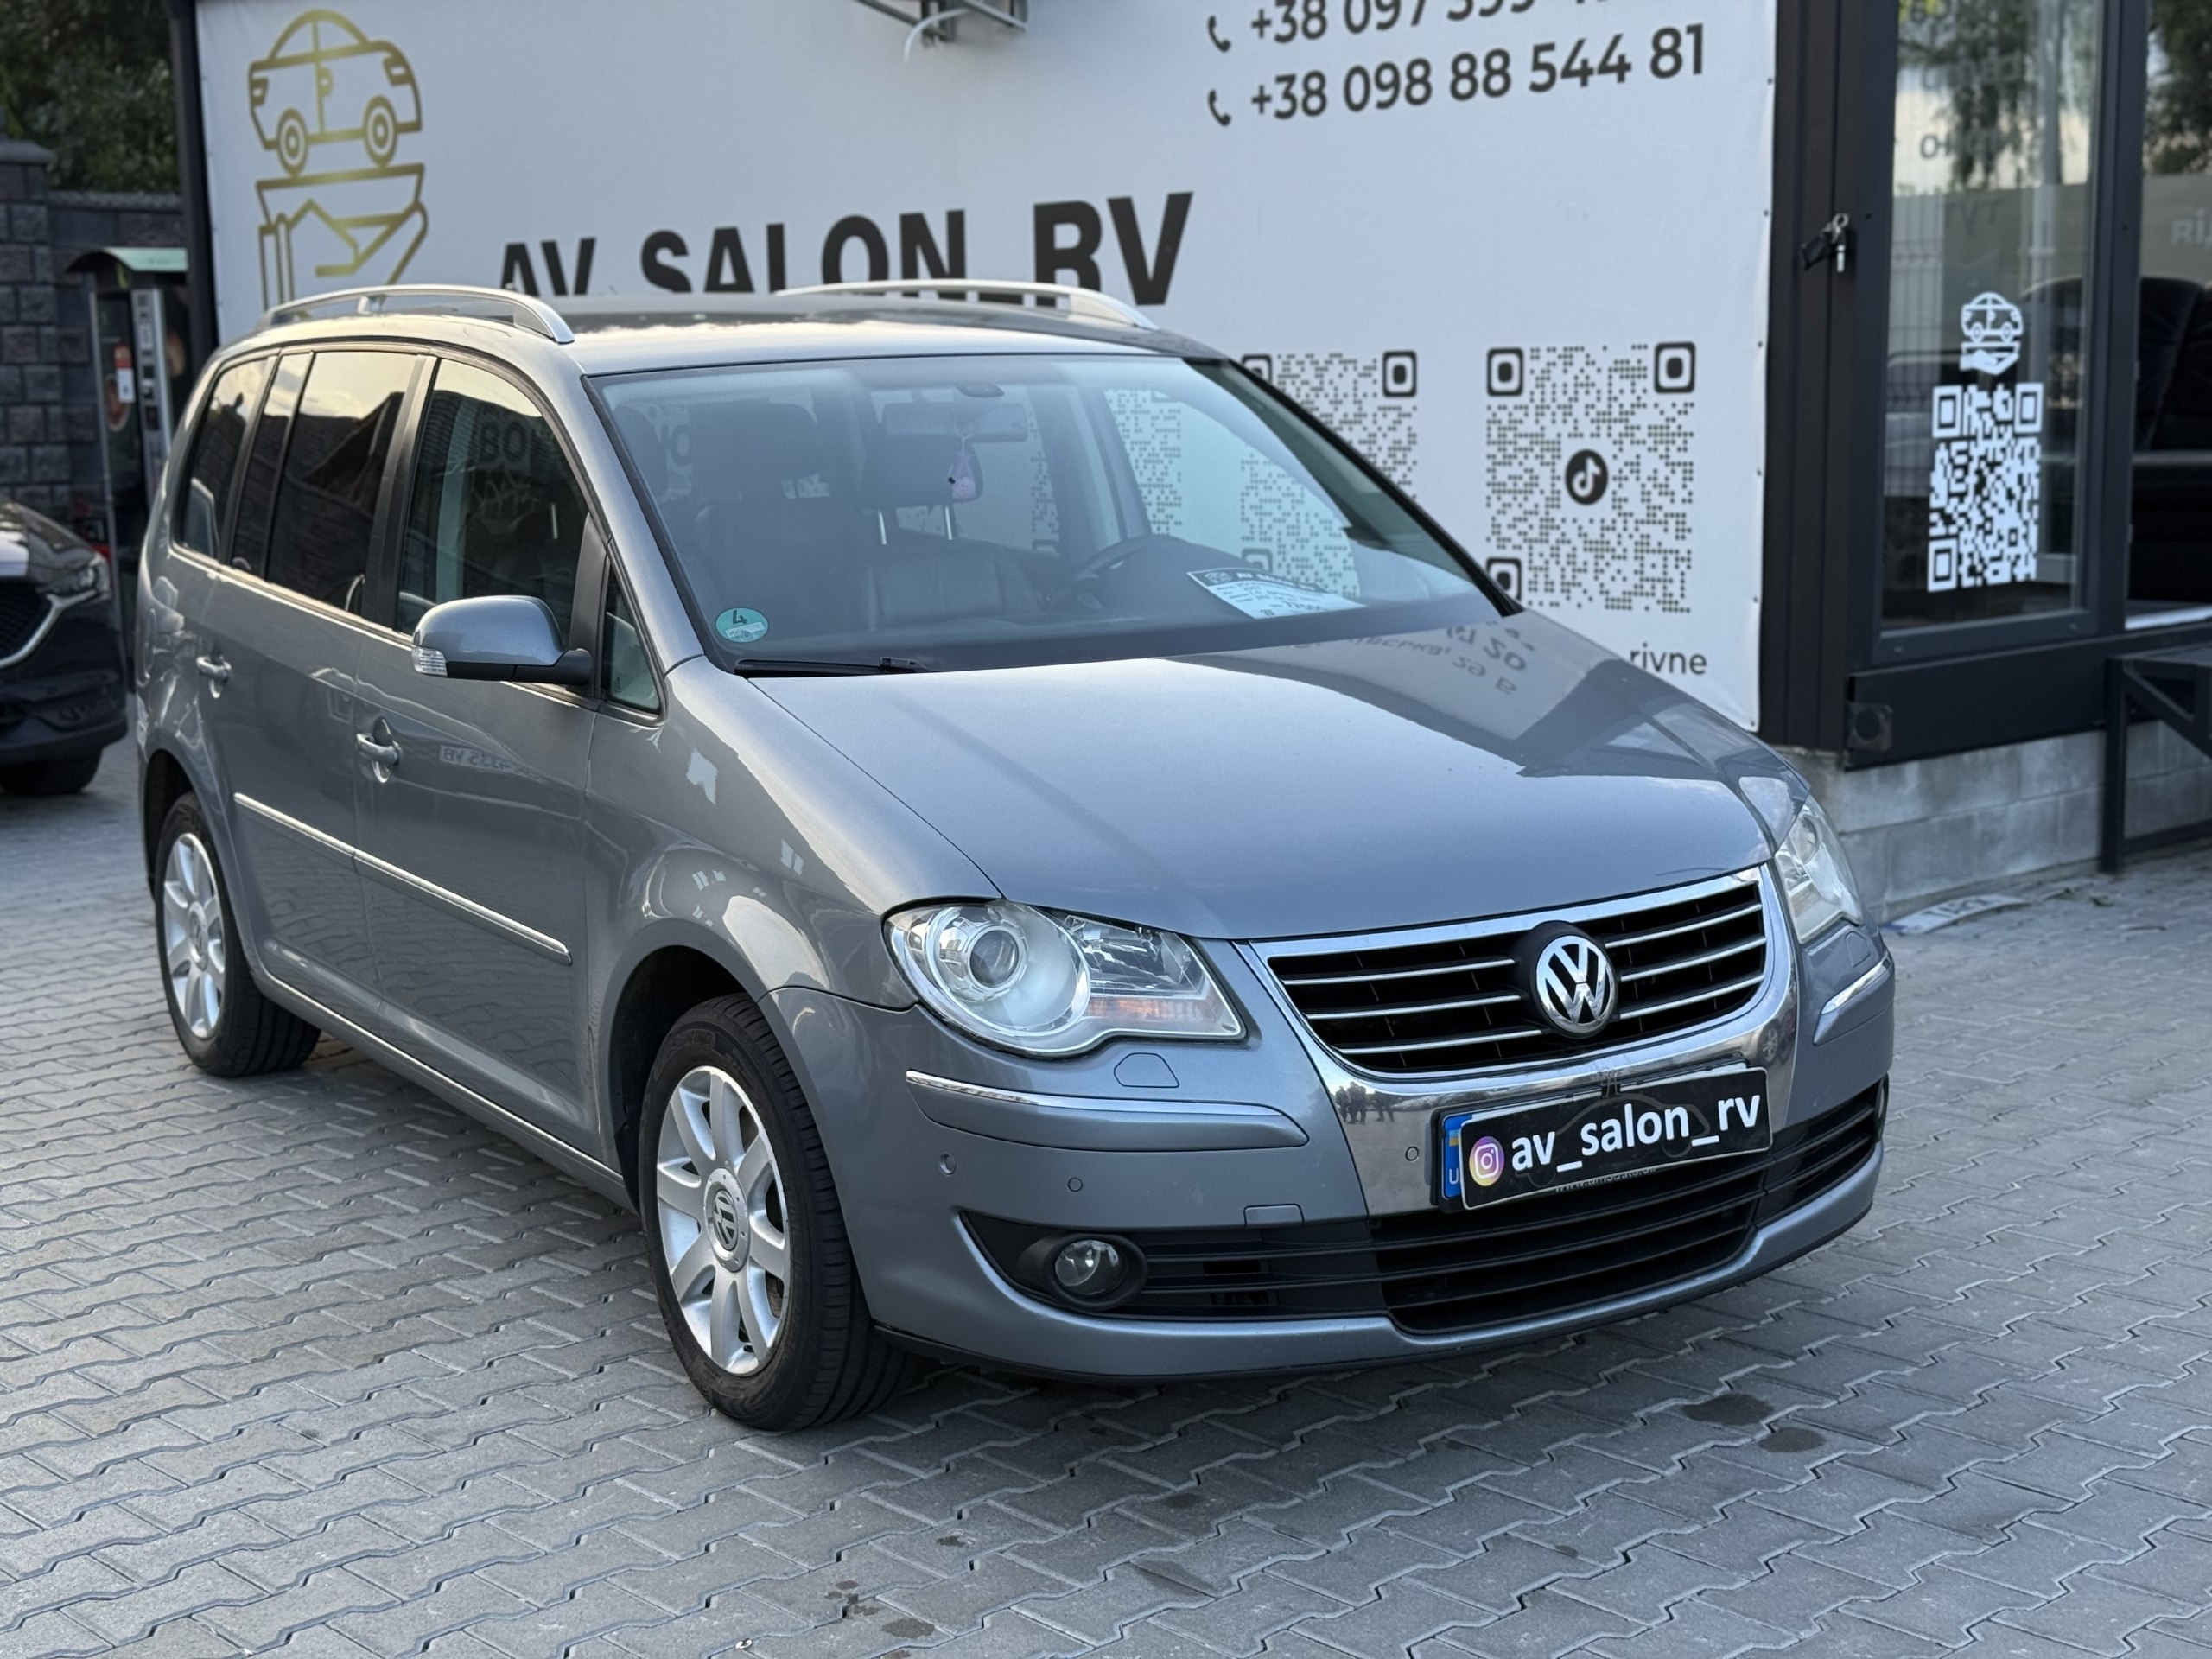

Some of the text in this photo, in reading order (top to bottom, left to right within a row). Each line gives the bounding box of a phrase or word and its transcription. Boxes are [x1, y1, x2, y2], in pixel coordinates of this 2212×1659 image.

[1251, 23, 1703, 120] +38 098 88 544 81
[1630, 642, 1707, 676] rivne
[1511, 1095, 1761, 1173] av_salon_rv
